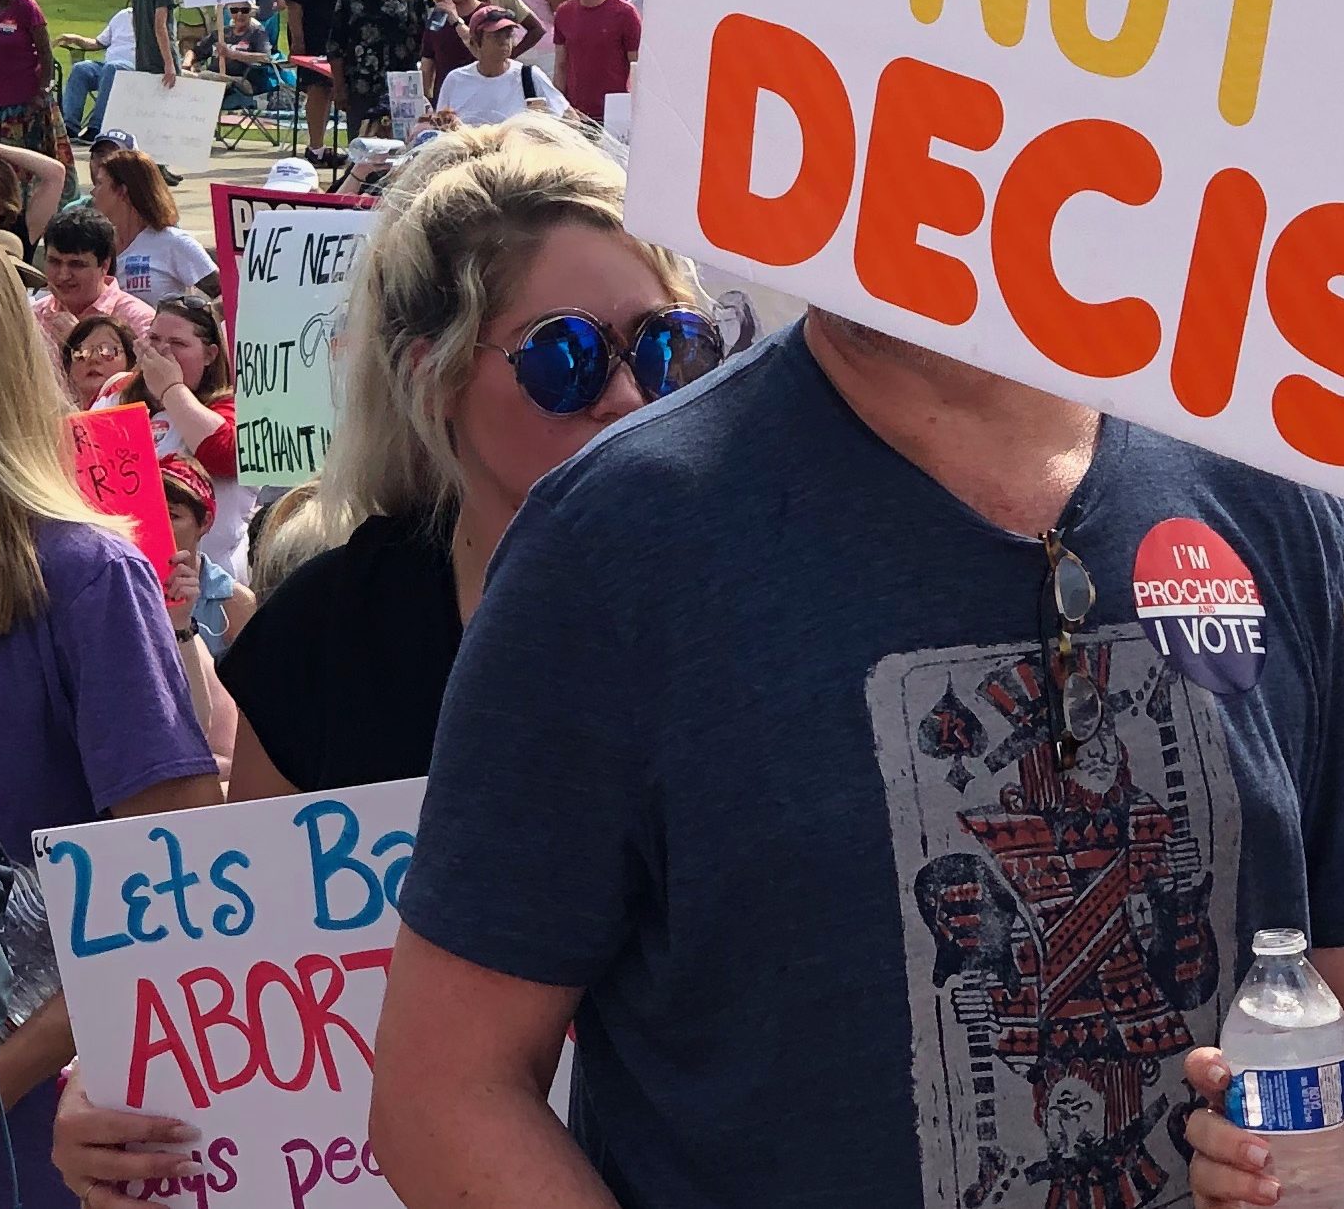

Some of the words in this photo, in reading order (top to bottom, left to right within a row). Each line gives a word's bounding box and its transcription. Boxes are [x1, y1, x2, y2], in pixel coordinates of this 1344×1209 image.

[248, 225, 293, 284] WE
[125, 275, 152, 289] VOTE
[236, 341, 296, 399] ABOUT
[237, 416, 316, 474] ELEPHANT
[88, 458, 142, 503] R'S
[1172, 544, 1211, 570] I'M
[1198, 605, 1216, 614] AND
[1154, 619, 1170, 656] I
[1177, 616, 1267, 655] VOTE
